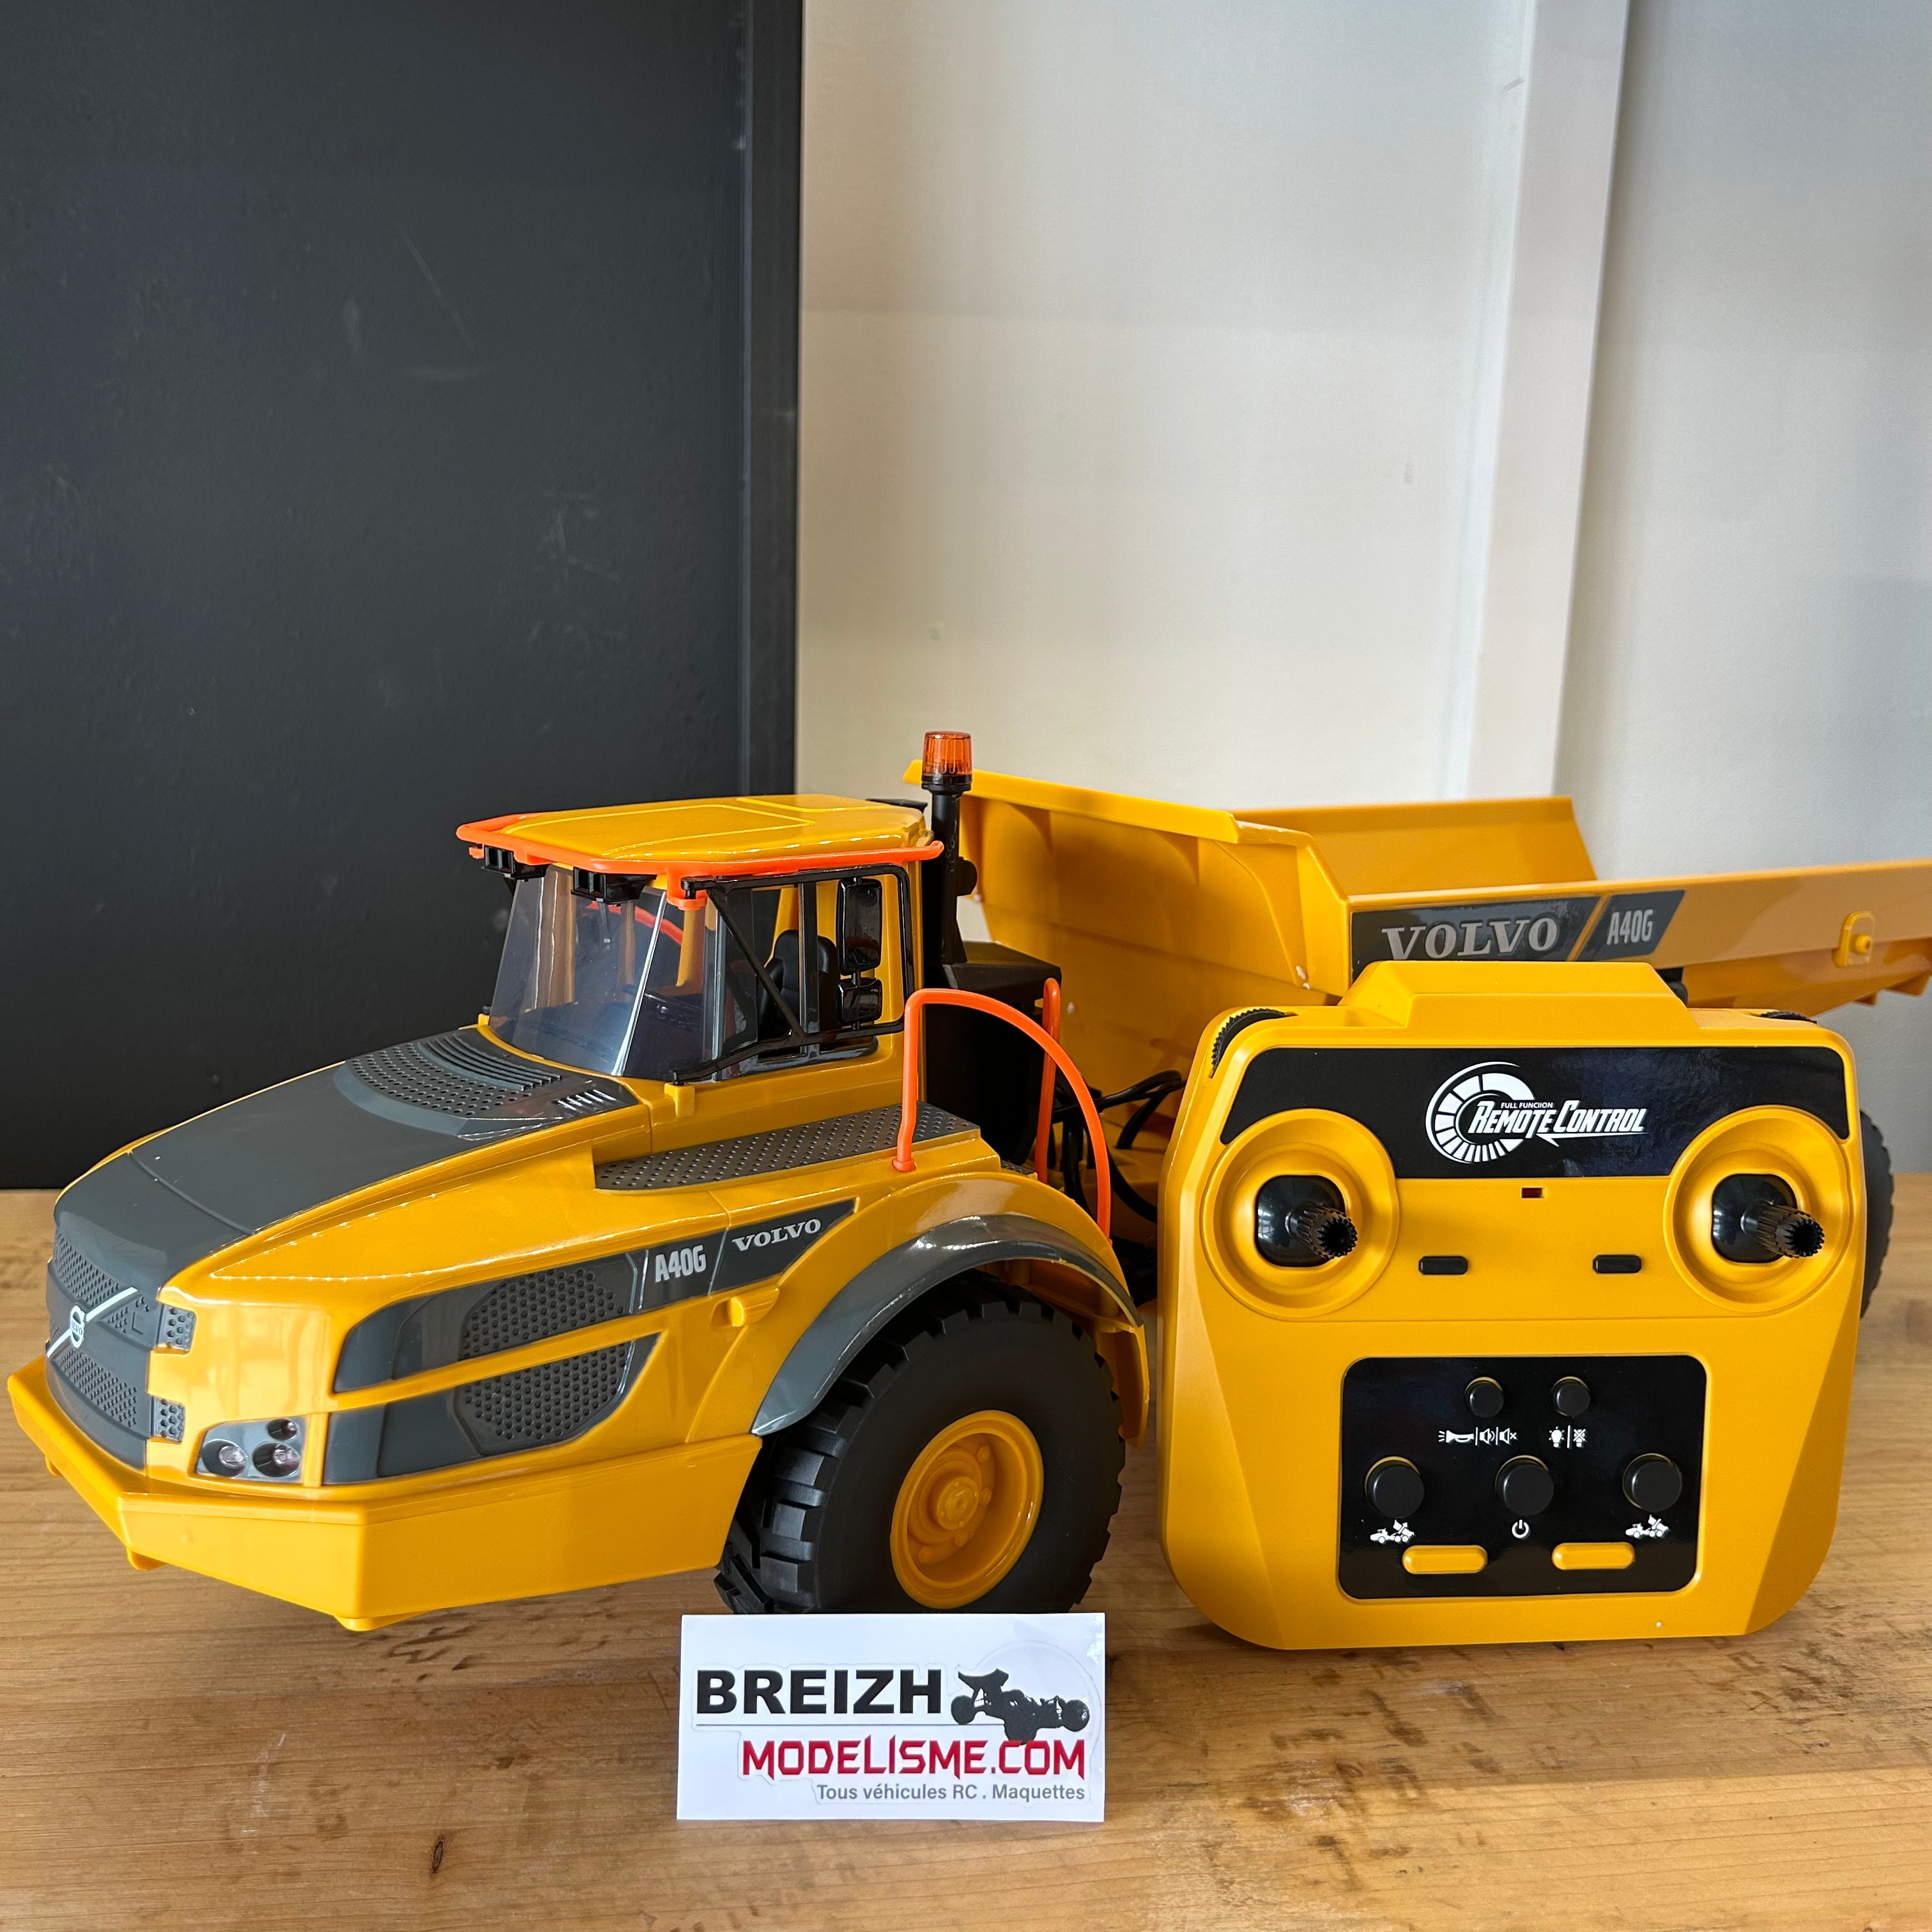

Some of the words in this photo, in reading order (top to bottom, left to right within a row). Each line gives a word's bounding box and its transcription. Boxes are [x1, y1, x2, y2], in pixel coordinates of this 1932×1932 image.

[1381, 917, 1558, 960] VOLVO
[1606, 908, 1653, 946] A40G
[1468, 1101, 1556, 1138] REMOTE
[1553, 1100, 1647, 1133] CONTROL
[655, 1245, 707, 1283] A40G
[732, 1218, 822, 1251] VOLVO
[696, 1669, 942, 1714] BREIZH
[742, 1735, 1085, 1781] MODELISME.COM
[817, 1784, 857, 1799] Tous
[863, 1784, 946, 1799] véhicules
[953, 1784, 977, 1799] RC
[992, 1784, 1085, 1802] Maquettes
